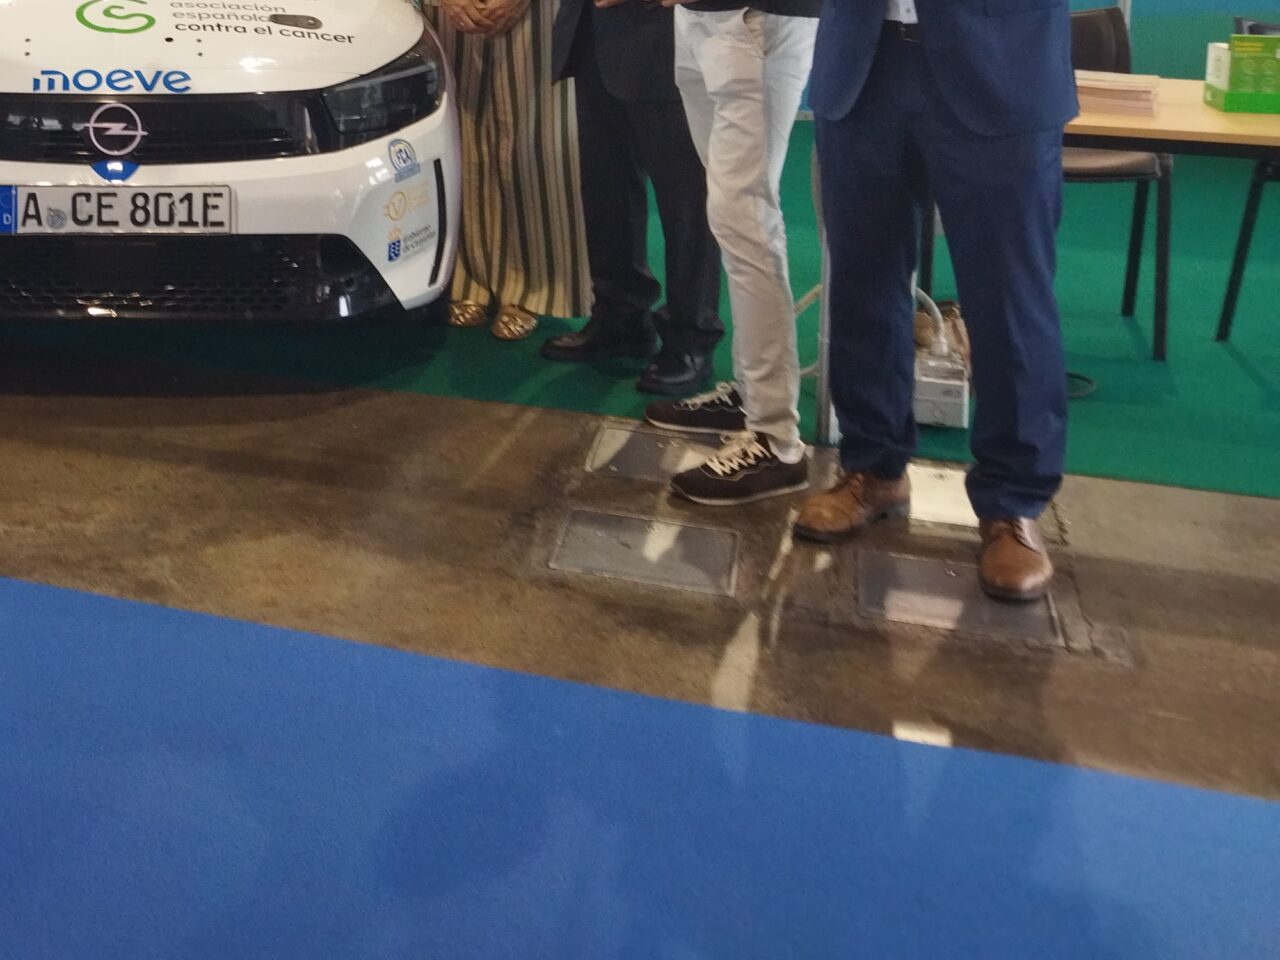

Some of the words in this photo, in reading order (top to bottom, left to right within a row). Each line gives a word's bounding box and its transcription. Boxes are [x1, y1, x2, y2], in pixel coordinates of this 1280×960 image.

[170, 0, 287, 14] asociación
[175, 21, 247, 34] contra
[254, 24, 273, 36] el
[32, 69, 192, 93] moeve
[21, 192, 44, 227] A
[71, 192, 119, 227] CE
[130, 192, 225, 227] 801E
[2, 213, 12, 225] D
